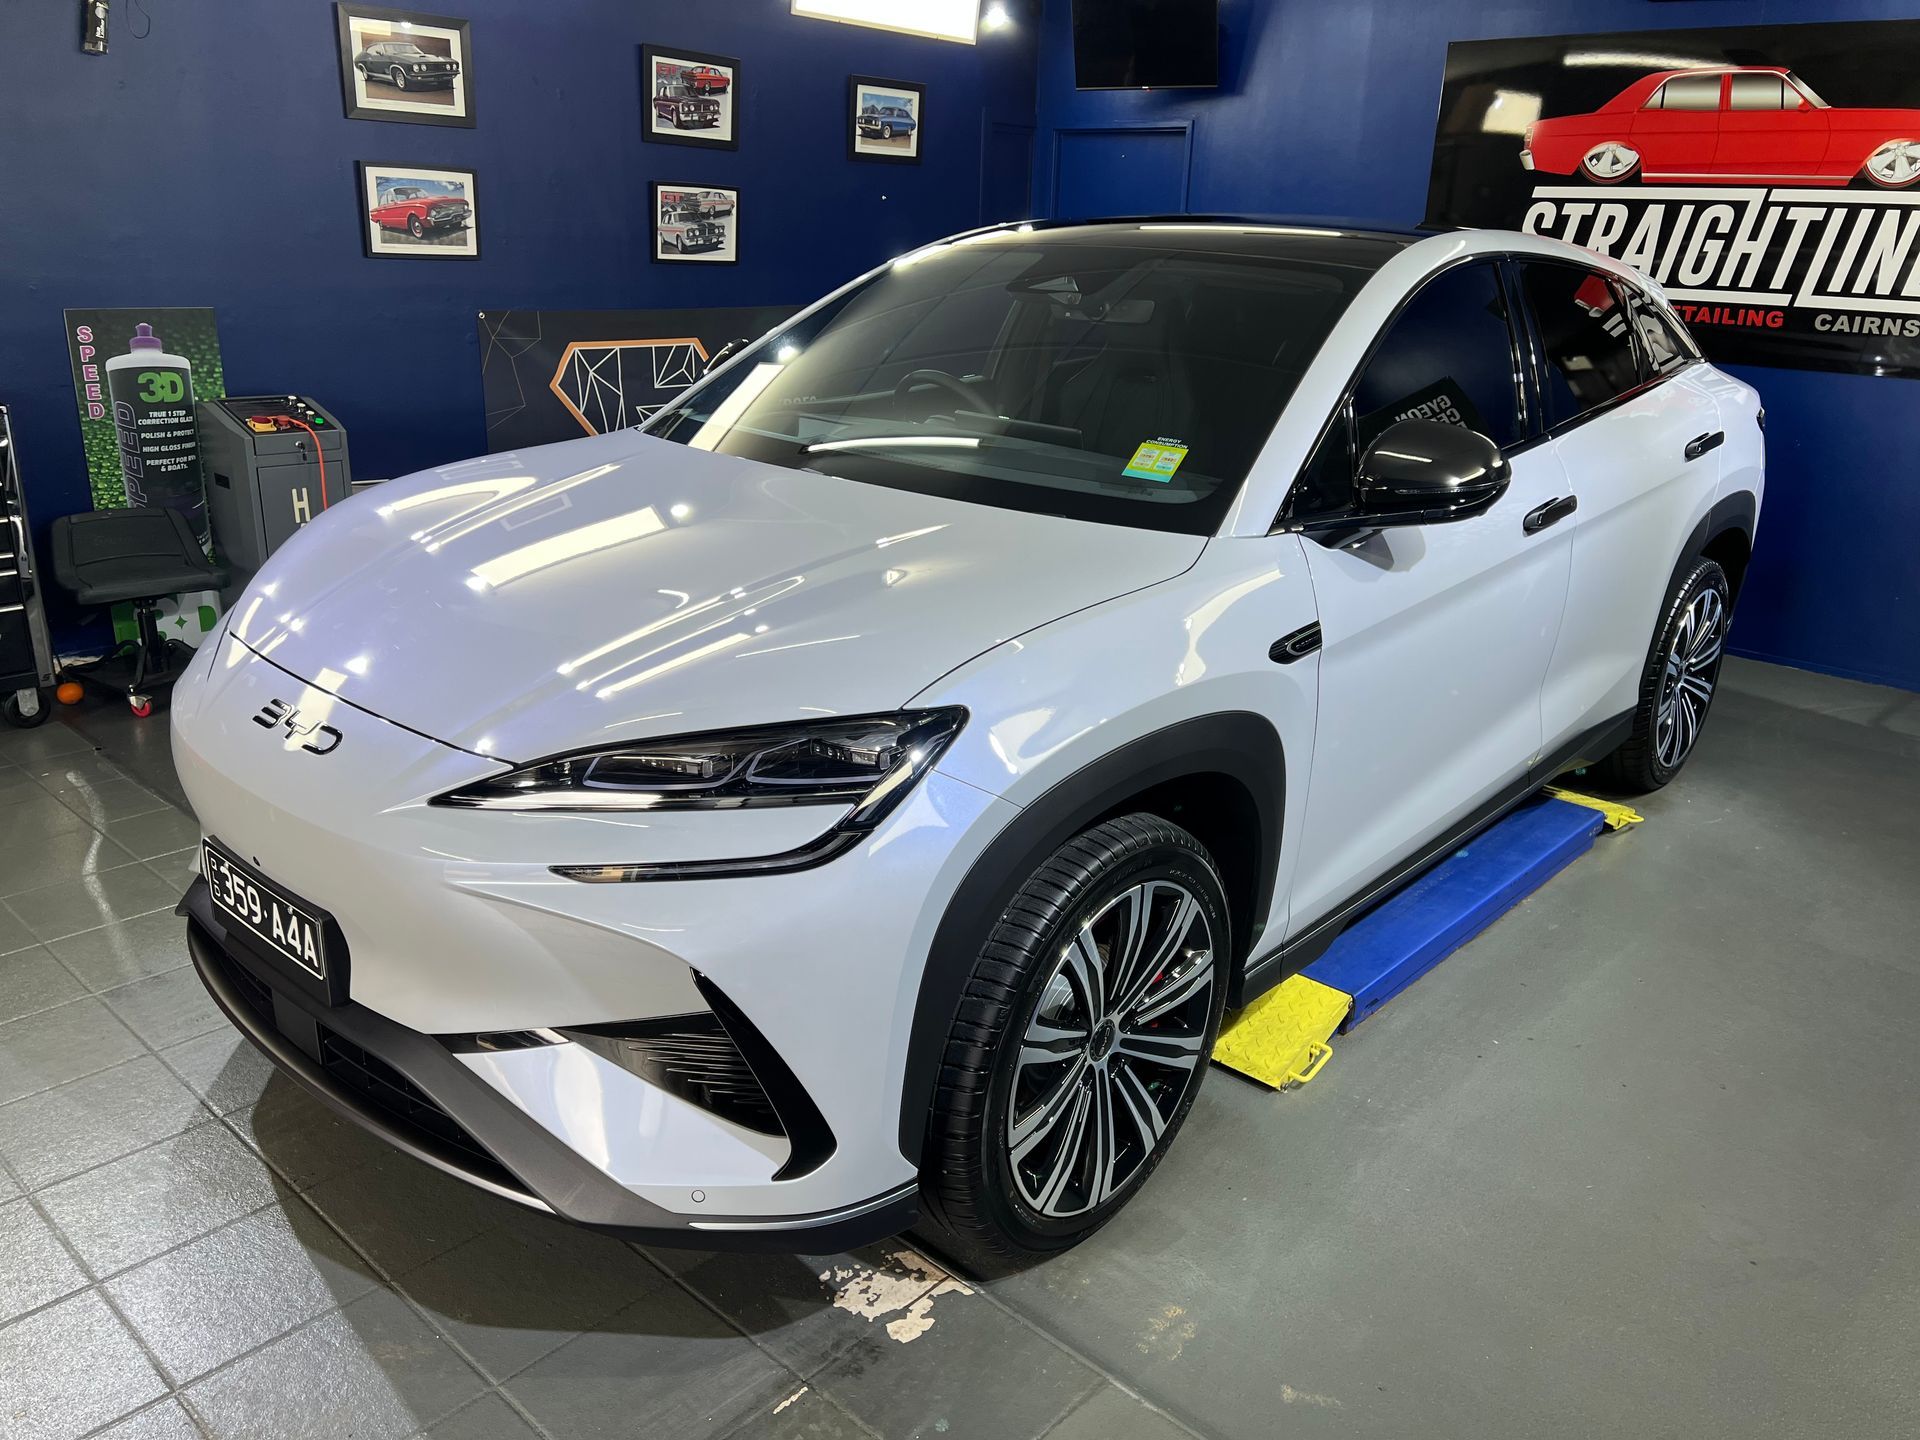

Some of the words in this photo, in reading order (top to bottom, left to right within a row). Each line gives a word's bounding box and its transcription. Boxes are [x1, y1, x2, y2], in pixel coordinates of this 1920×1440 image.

[661, 191, 684, 204] GT
[1522, 187, 1920, 314] TRAIGHTLIN
[1814, 313, 1920, 338] CAIRNS
[77, 325, 105, 420] SPEED
[138, 371, 184, 403] 3D
[1146, 439, 1188, 449] CONSUMPTION
[1157, 436, 1182, 444] ENERGY
[114, 401, 147, 509] PEED
[146, 458, 176, 466] PERFECT
[252, 698, 343, 755] BYD
